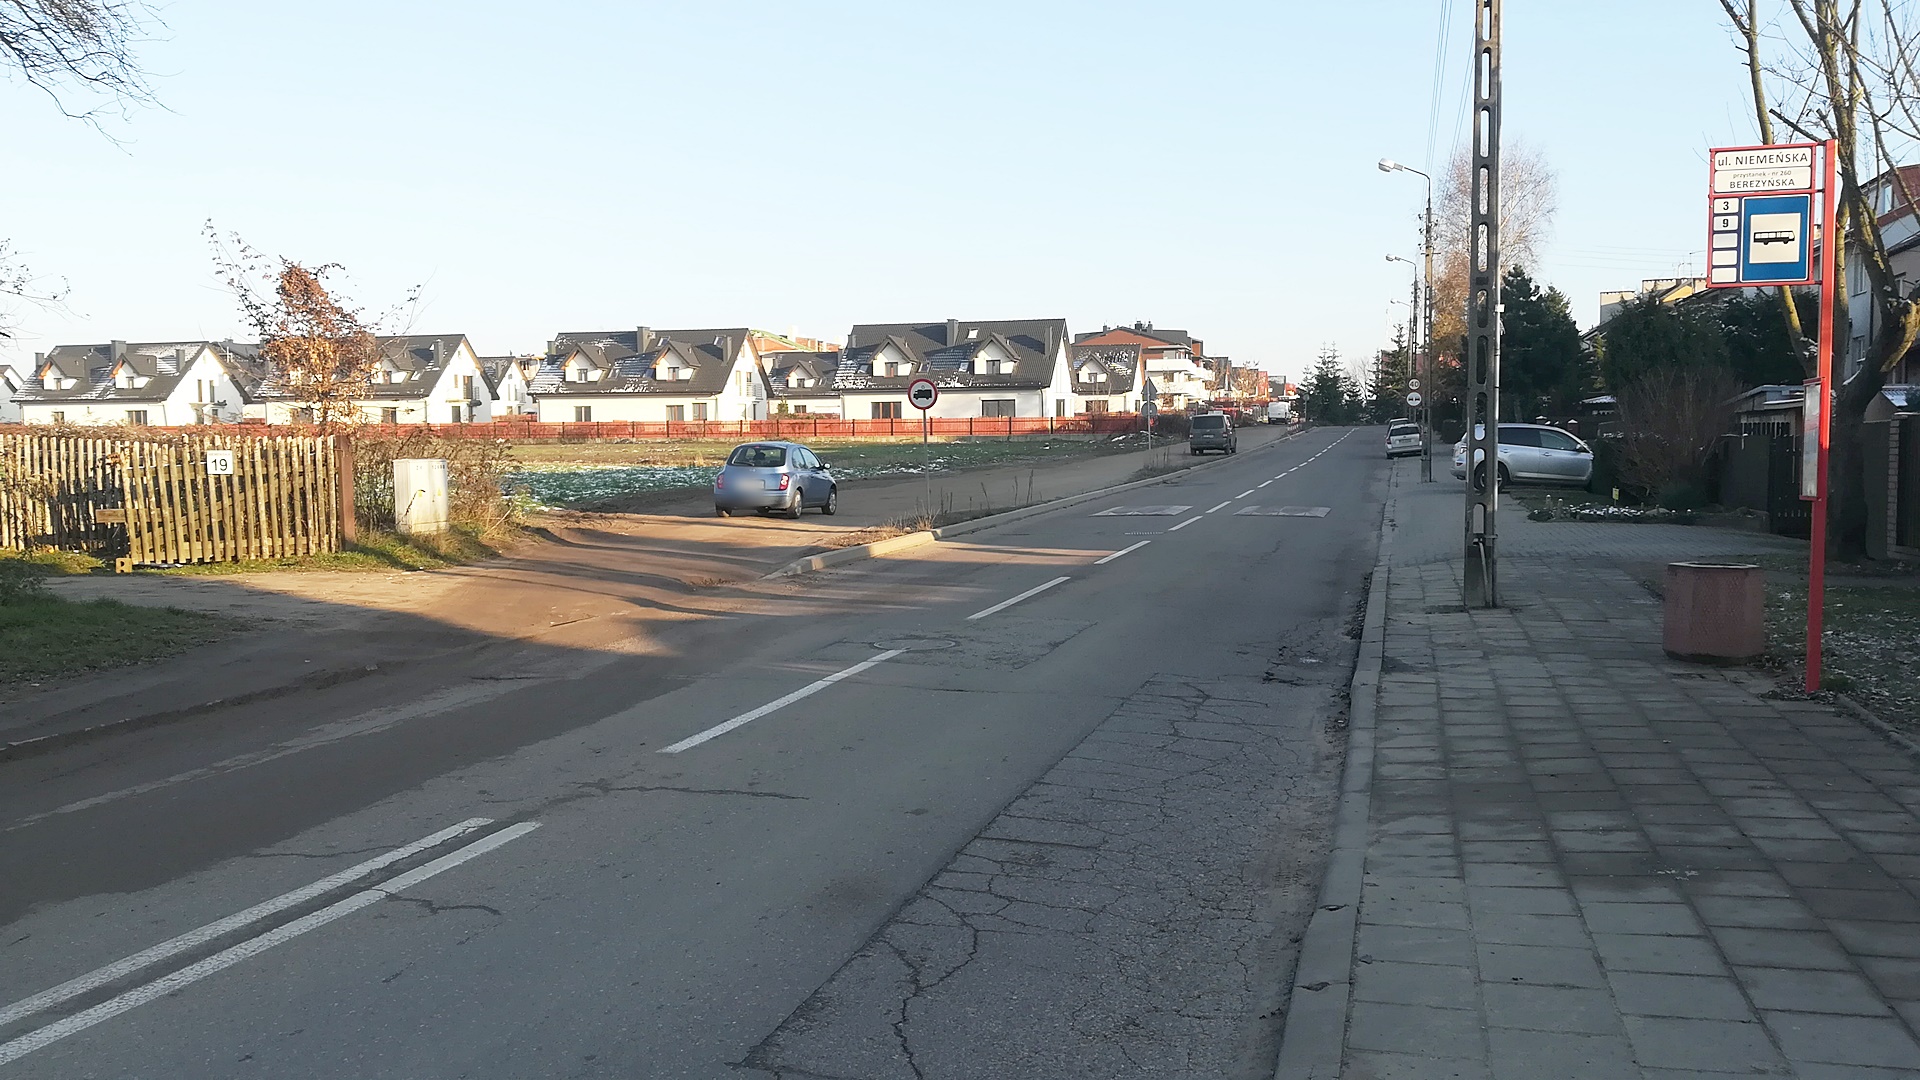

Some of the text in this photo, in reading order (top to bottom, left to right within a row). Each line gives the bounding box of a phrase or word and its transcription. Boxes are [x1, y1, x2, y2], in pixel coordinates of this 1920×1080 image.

[1718, 151, 1808, 166] ul. NIEMEŃSKA
[1729, 178, 1795, 189] BEREZYŃSKA
[1723, 201, 1730, 210] 3
[1722, 218, 1729, 228] 9
[211, 458, 228, 471] 19
